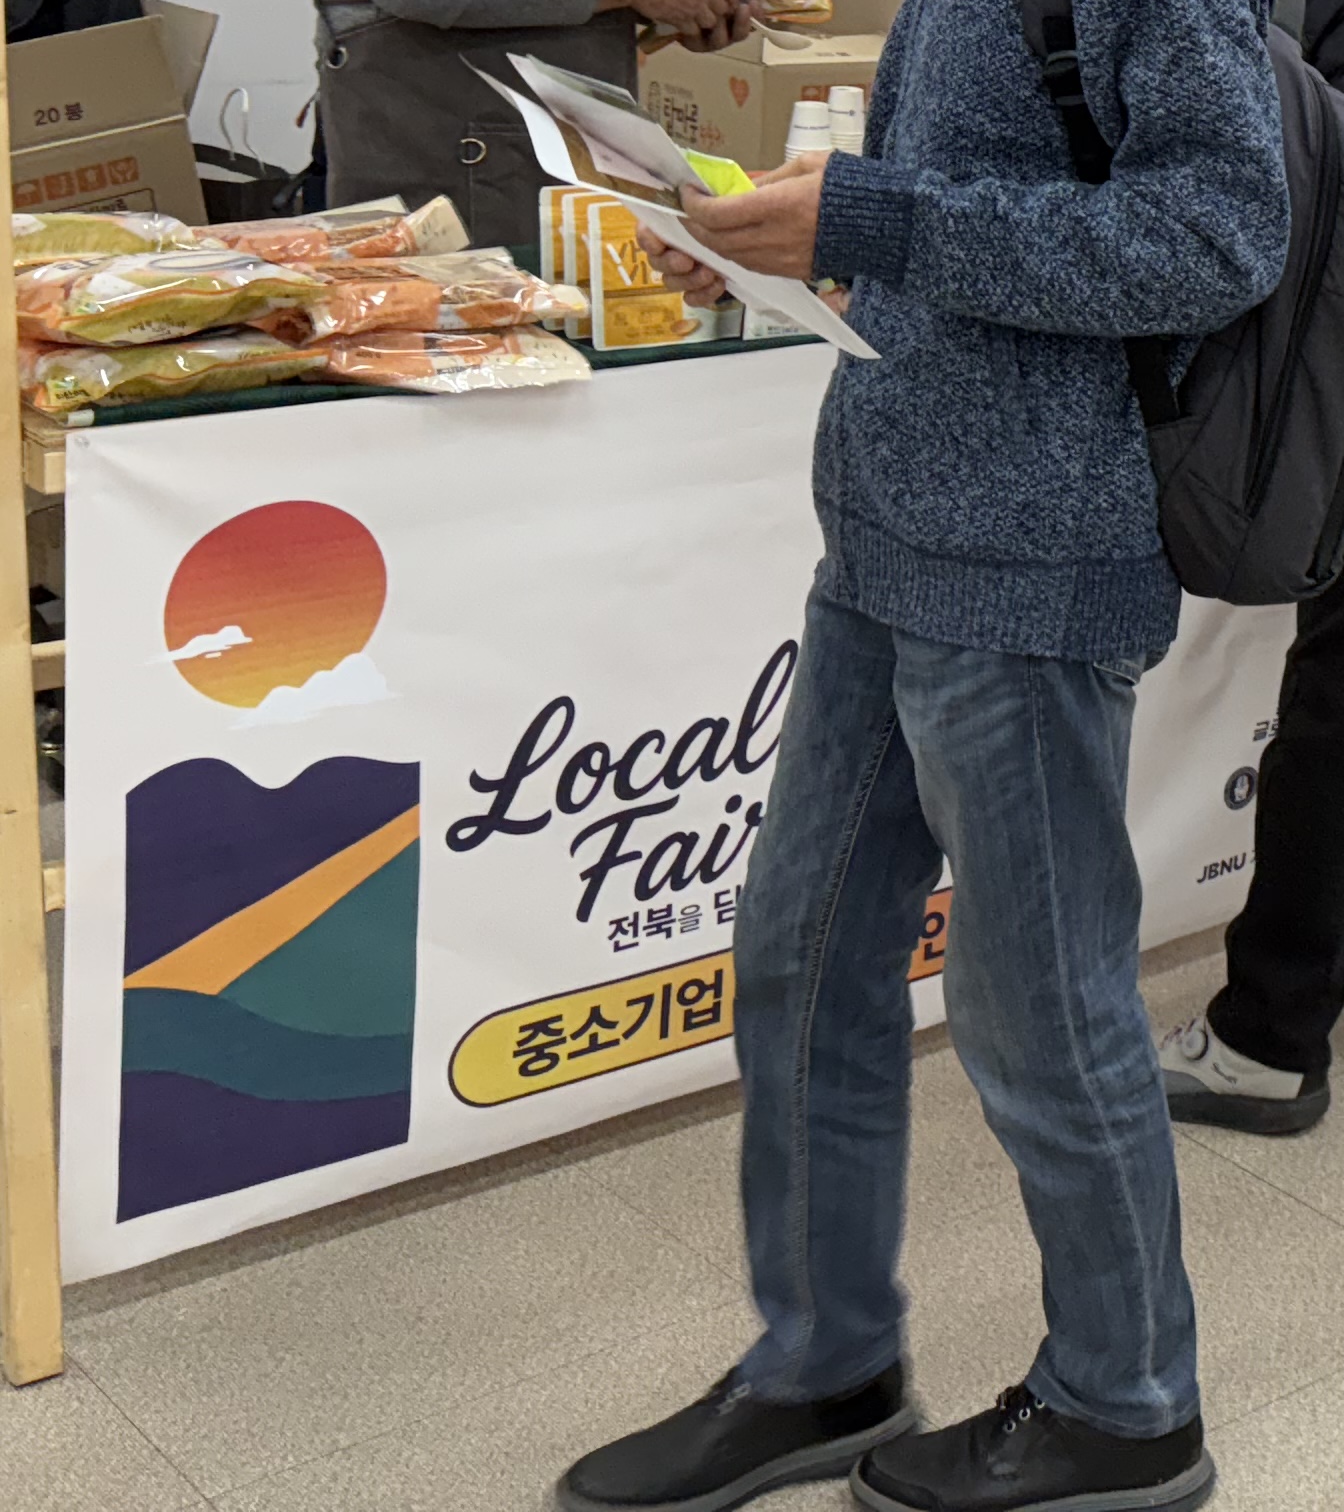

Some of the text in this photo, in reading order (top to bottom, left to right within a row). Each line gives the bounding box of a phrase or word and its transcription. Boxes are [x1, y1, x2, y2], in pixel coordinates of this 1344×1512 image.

[34, 102, 84, 127] 20 봉
[445, 639, 800, 852] Local
[1196, 852, 1247, 884] JBNU
[606, 900, 703, 953] 전북을
[511, 976, 724, 1077] 중소기업
